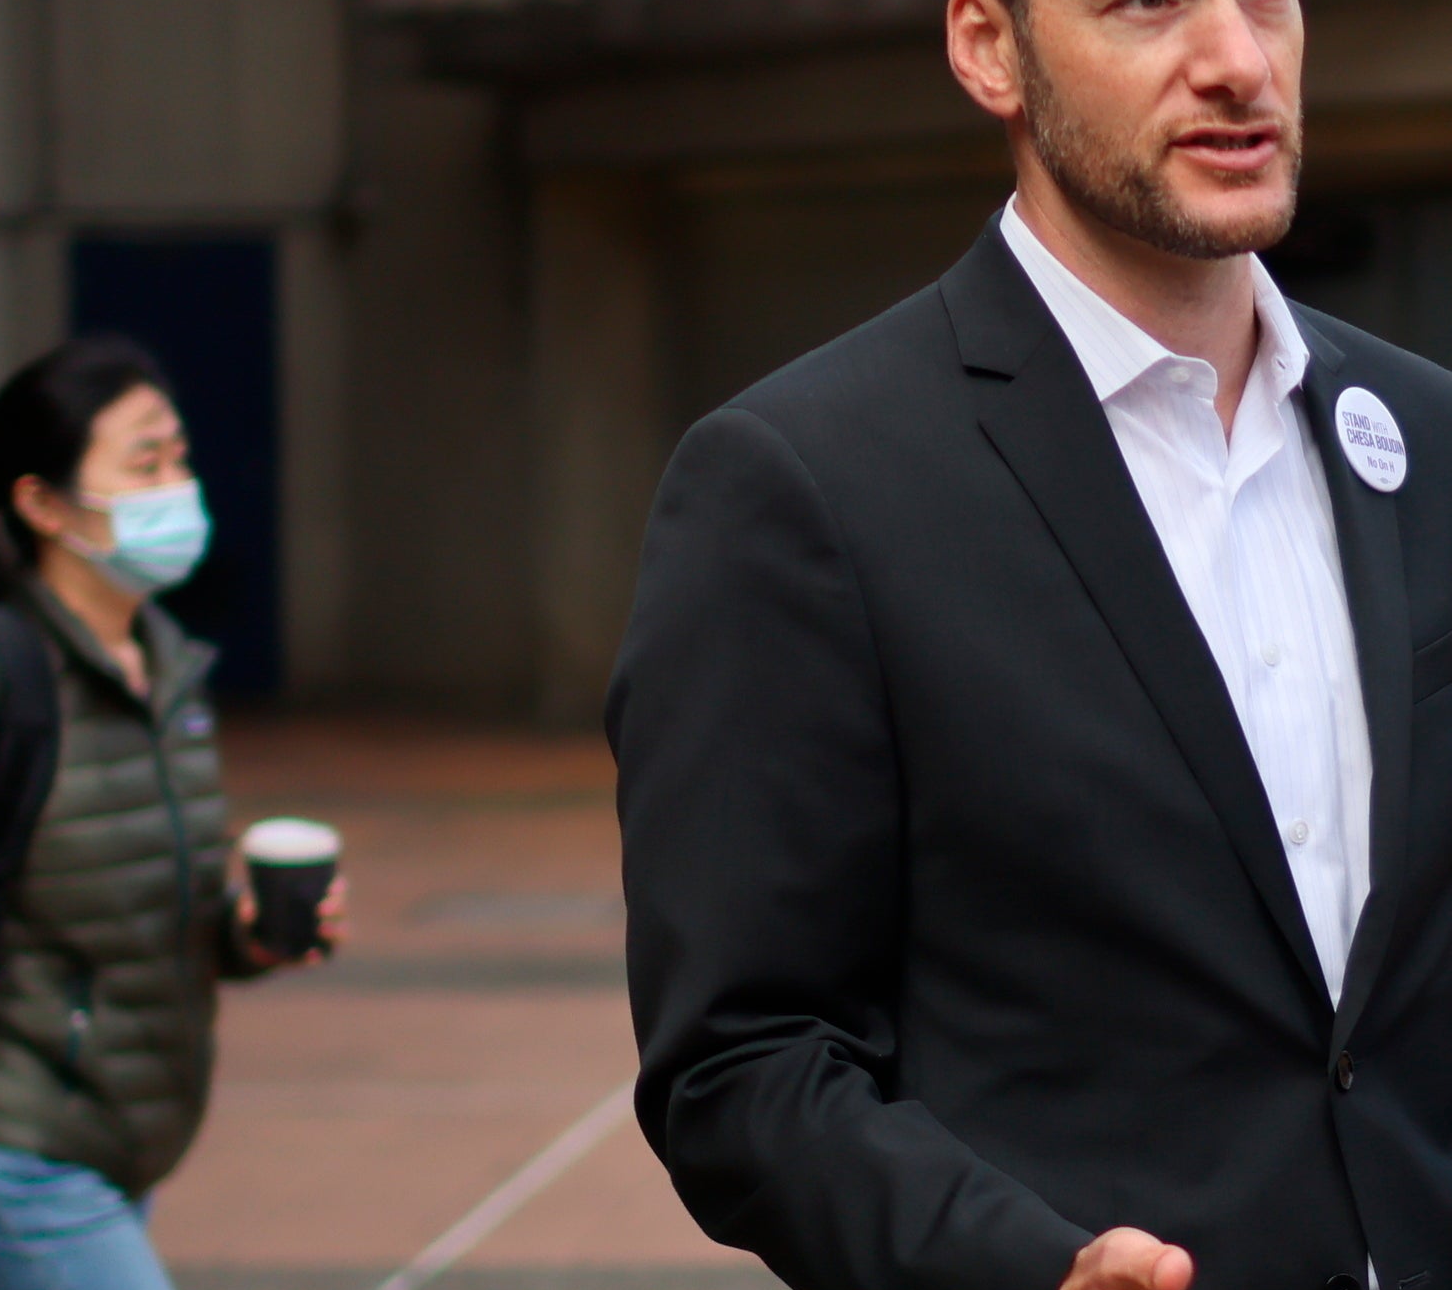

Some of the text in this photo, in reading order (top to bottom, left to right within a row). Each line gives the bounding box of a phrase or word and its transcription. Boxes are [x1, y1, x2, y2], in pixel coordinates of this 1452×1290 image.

[1342, 411, 1388, 435] STAND WITH
[1347, 429, 1405, 457] CHESA BOUDIN
[1367, 456, 1395, 473] No On H
